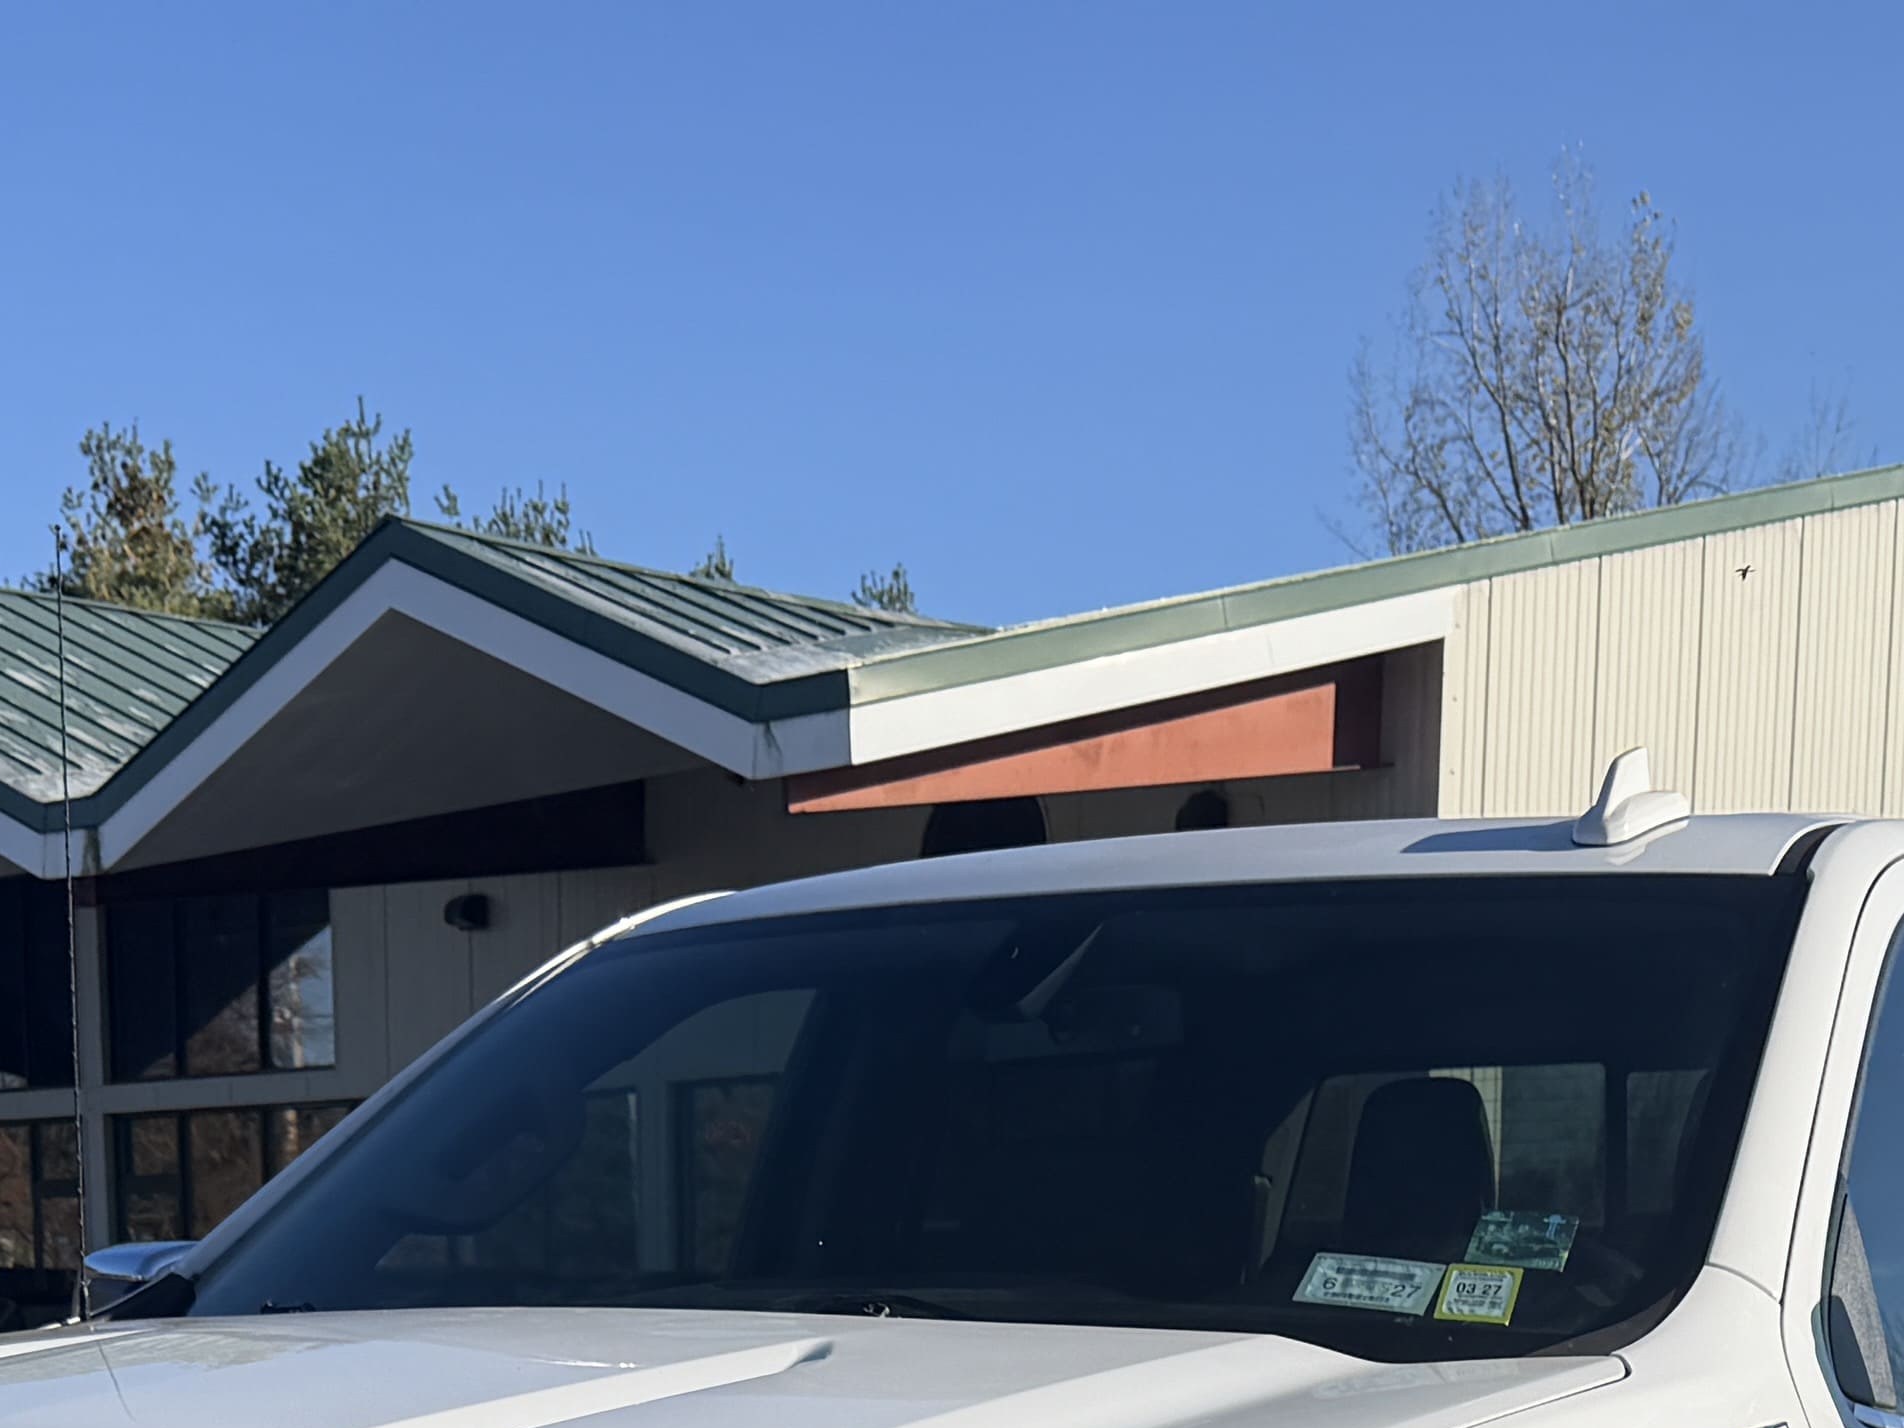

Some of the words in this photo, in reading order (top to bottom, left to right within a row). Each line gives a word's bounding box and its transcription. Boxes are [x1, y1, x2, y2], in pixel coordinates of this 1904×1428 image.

[1322, 1277, 1338, 1290] 6
[1390, 1284, 1422, 1299] 27
[1456, 1282, 1476, 1295] 03
[1482, 1284, 1503, 1297] 27
